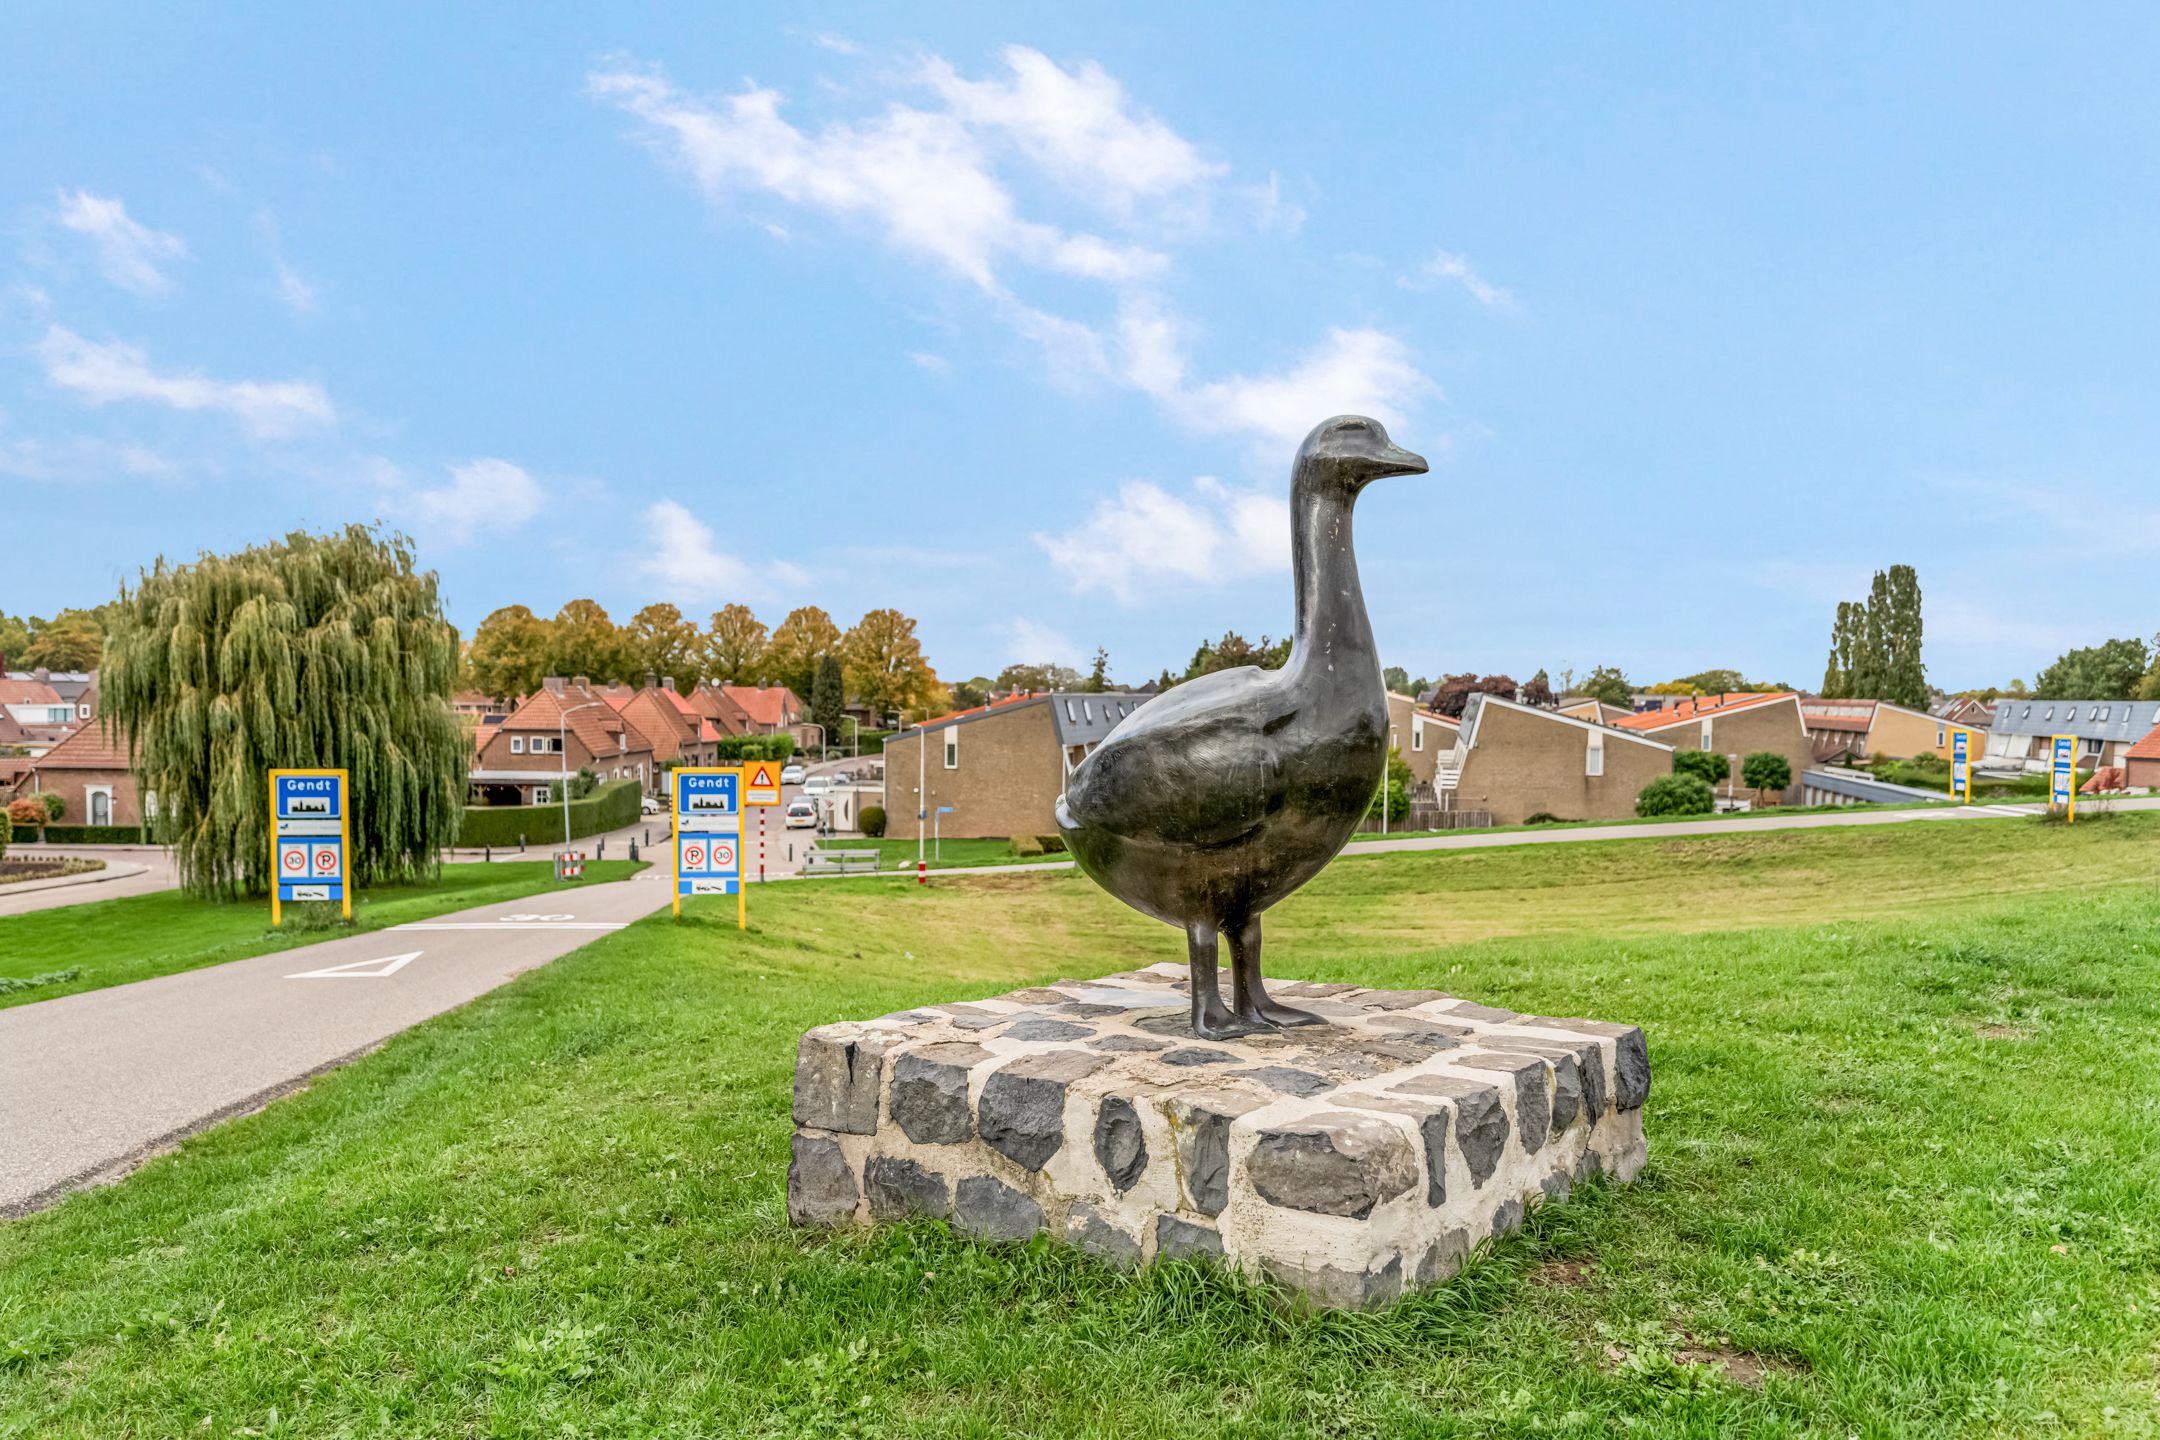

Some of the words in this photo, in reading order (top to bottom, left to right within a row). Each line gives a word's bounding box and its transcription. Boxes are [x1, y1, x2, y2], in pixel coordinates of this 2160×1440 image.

[287, 780, 331, 791] Gendt
[689, 777, 729, 788] Gendt
[717, 851, 730, 859] 30
[289, 856, 302, 865] 30
